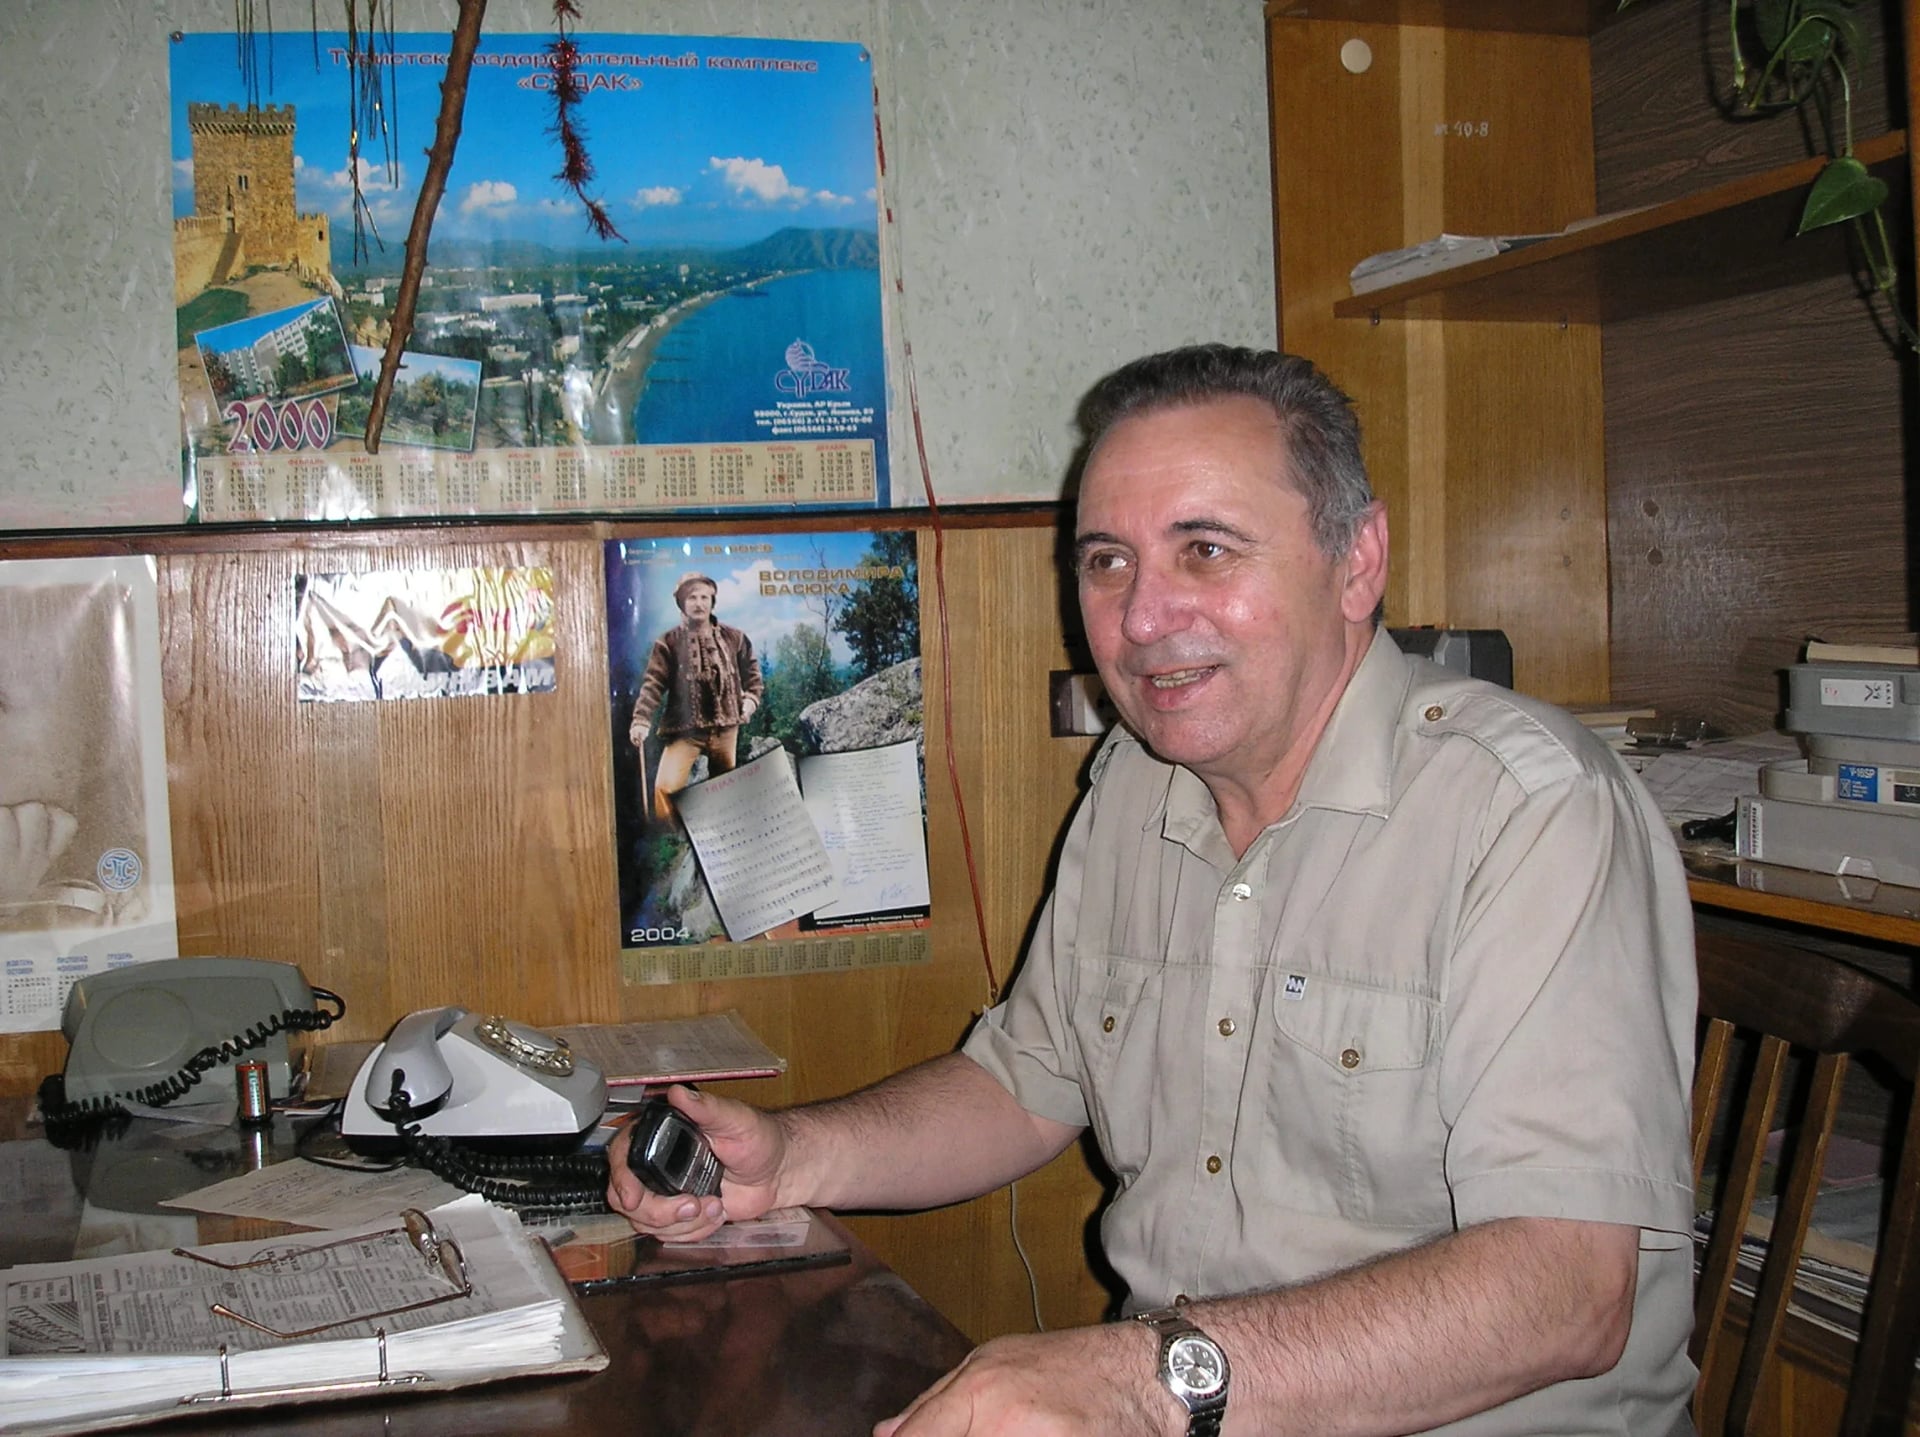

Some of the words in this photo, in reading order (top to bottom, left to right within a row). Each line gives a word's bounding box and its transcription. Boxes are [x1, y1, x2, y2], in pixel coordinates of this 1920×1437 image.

[706, 55, 818, 73] комплекс
[517, 72, 643, 92] «СДАК»
[224, 398, 331, 453] 2000
[759, 566, 904, 582] ВОЛОДИМИРА
[760, 582, 850, 597] ІВАСЮКА
[631, 927, 690, 942] 2004
